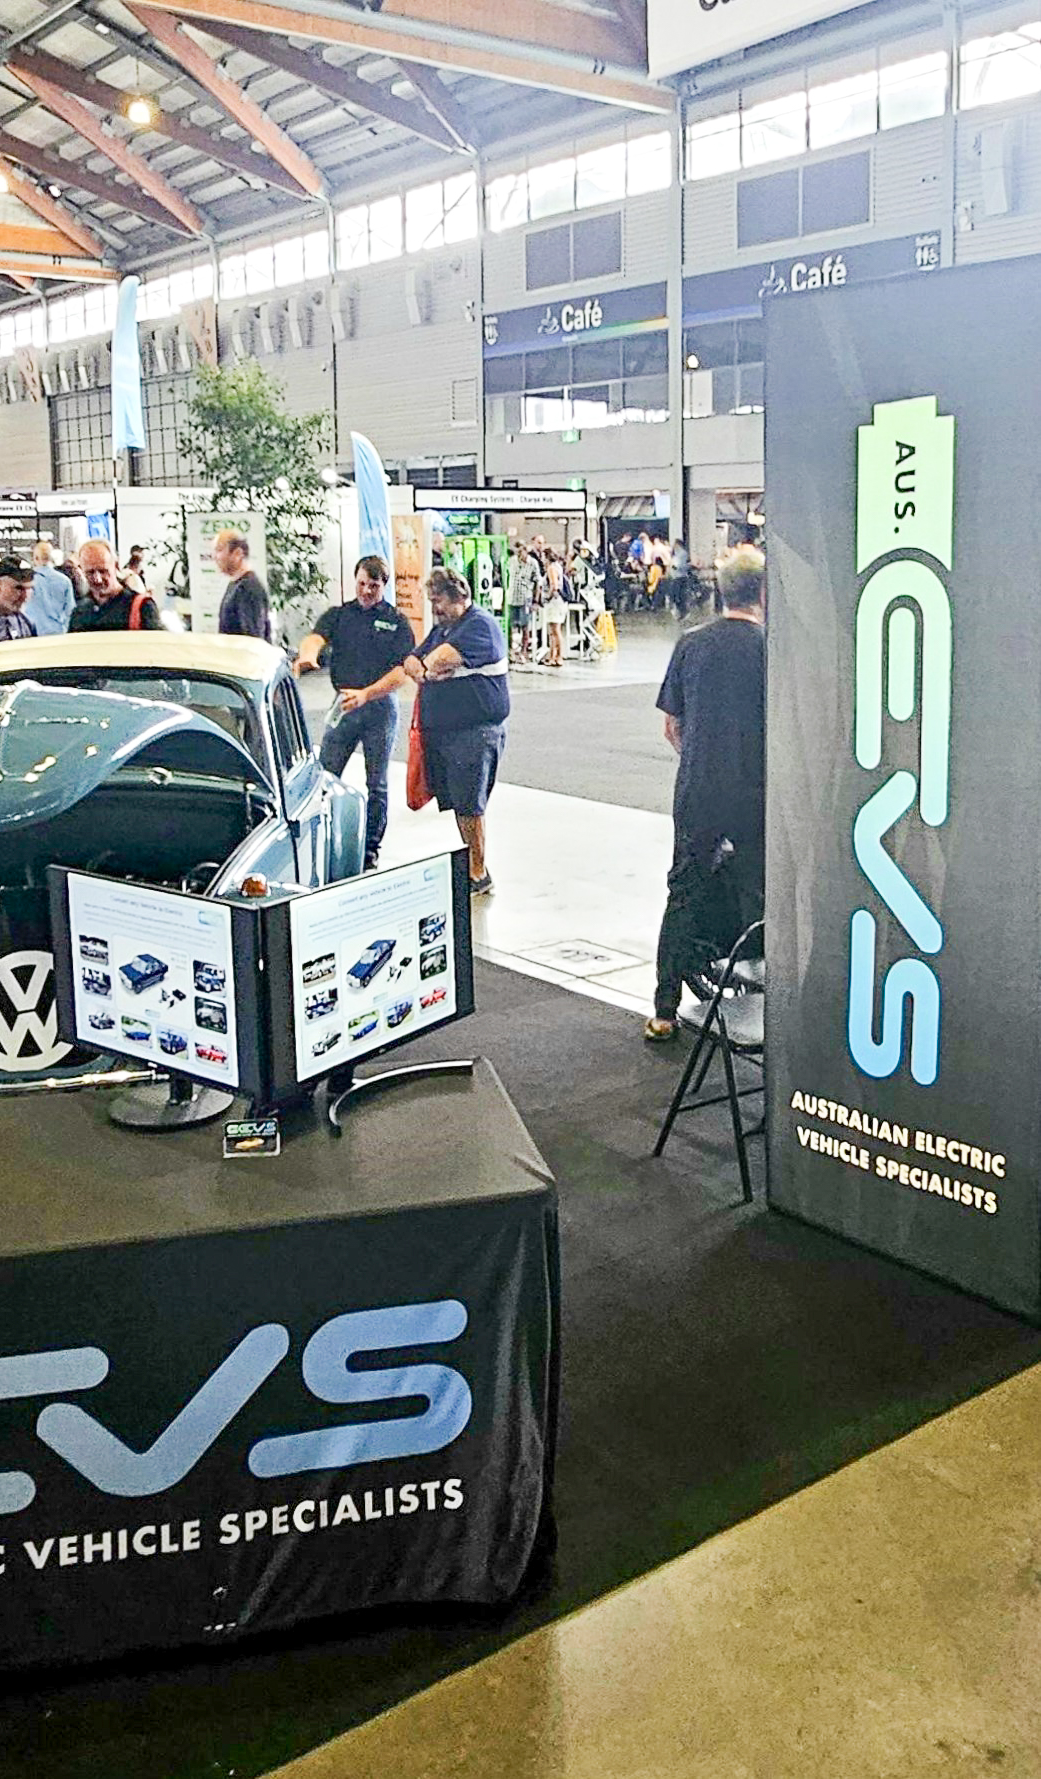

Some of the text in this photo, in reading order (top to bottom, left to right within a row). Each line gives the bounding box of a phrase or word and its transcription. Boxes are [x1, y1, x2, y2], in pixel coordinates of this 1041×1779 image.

[561, 299, 603, 332] Café
[791, 254, 847, 292] Café
[894, 440, 916, 535] AUS.
[790, 1090, 1006, 1178] AUSTRALIAN ELECTRIC
[796, 1126, 998, 1214] VEHICLE SPECIALISTS
[24, 1519, 201, 1571] VEHICLE
[219, 1478, 465, 1545] SPECIALISTS
